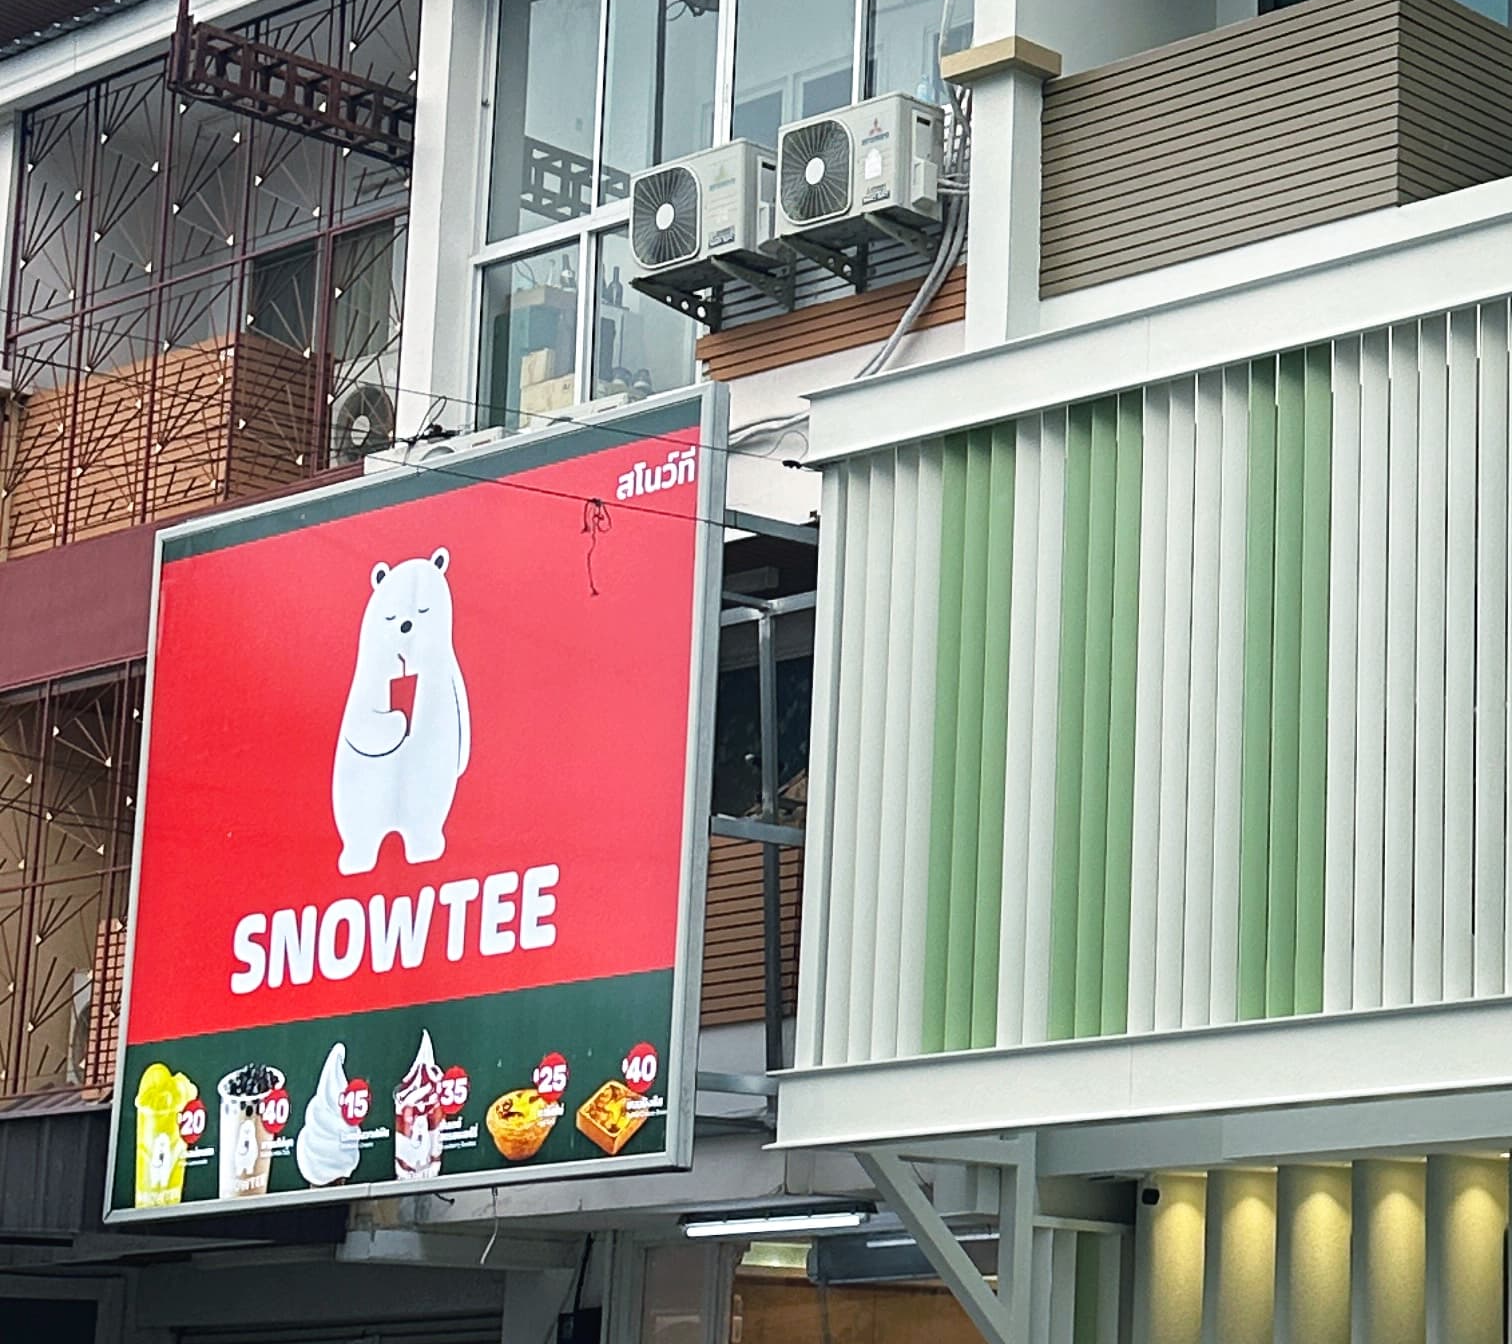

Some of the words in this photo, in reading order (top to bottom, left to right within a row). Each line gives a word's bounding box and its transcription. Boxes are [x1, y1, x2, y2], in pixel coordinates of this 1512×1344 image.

[616, 445, 697, 501] สโนว์ที
[229, 863, 560, 995] SNOWTEE
